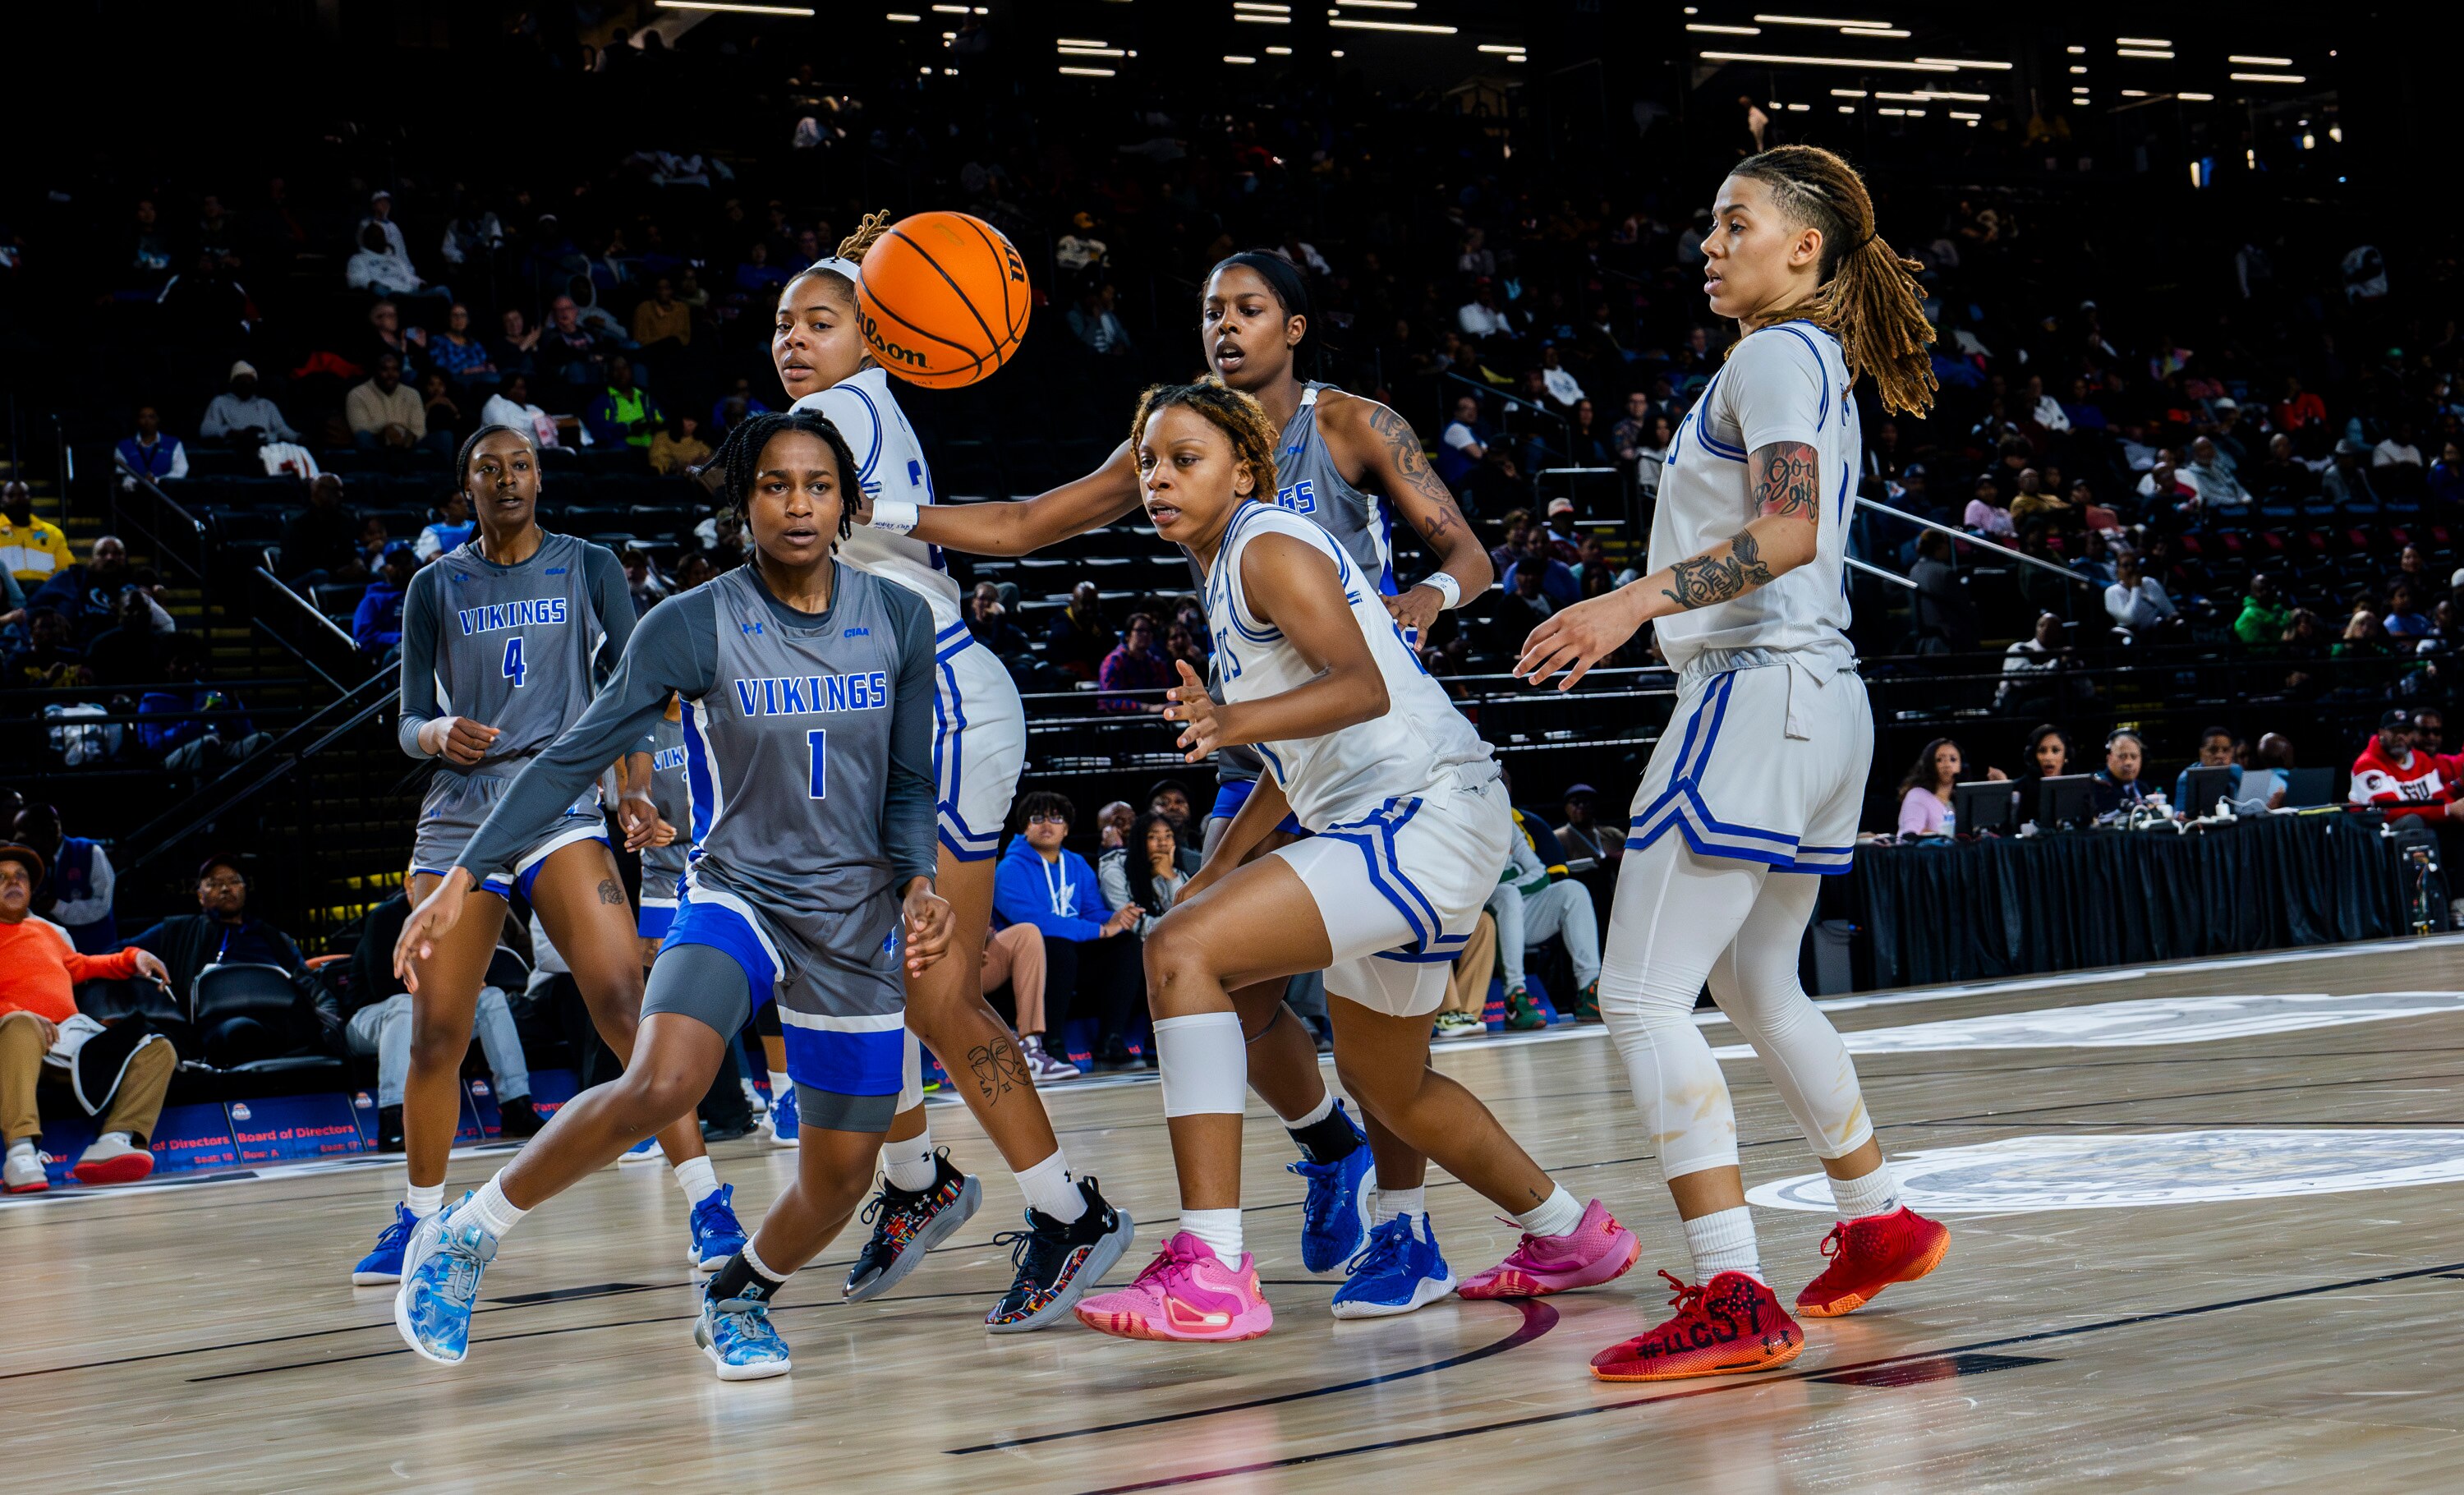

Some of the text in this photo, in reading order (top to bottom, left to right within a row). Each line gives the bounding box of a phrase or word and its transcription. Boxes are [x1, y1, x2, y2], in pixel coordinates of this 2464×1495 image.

[1275, 479, 1317, 514] GS
[458, 597, 567, 636] VIKINGS
[844, 628, 870, 638] CIAA
[502, 636, 527, 688] 4
[734, 670, 887, 716] VIKINGS
[807, 728, 826, 800] 1
[152, 1134, 230, 1152] of Directors
[237, 1124, 355, 1143] Board of Directors
